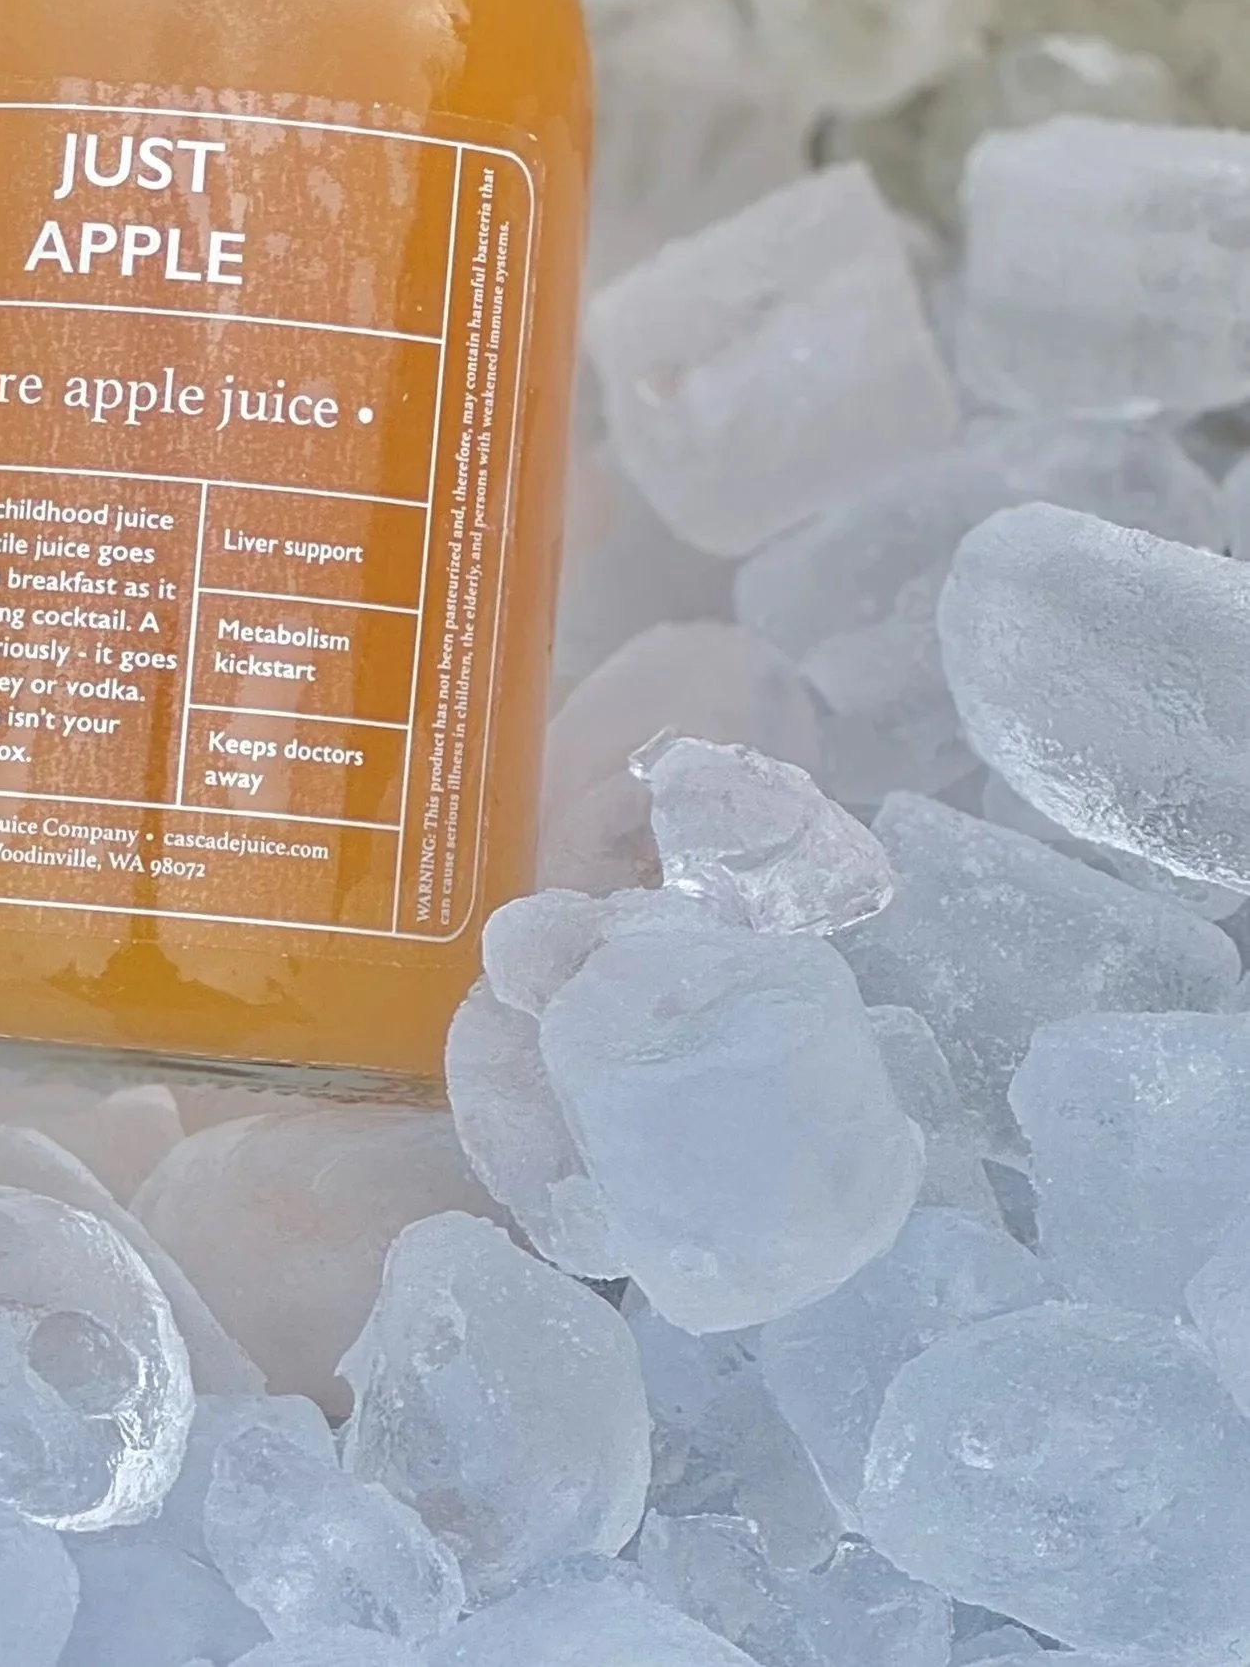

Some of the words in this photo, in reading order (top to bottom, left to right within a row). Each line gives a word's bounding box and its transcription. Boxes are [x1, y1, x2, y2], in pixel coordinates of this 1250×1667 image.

[53, 132, 226, 200] JUST
[478, 168, 495, 199] that
[472, 202, 492, 264] bacteria
[23, 220, 246, 285] APPLE
[495, 221, 510, 284] systems.
[466, 265, 486, 329] harmful
[489, 285, 504, 350] immune
[465, 332, 480, 390] contain
[63, 366, 205, 426] apple
[215, 374, 339, 432] juice
[462, 392, 478, 425] may
[481, 352, 498, 428] weakened
[452, 428, 473, 502] therefore,
[477, 431, 491, 466] with
[474, 469, 488, 528] persons
[114, 507, 175, 533] juice
[450, 505, 467, 539] and,
[34, 536, 91, 561] juice
[97, 545, 156, 567] goes
[223, 528, 279, 554] Liver
[284, 540, 364, 565] support
[469, 531, 483, 561] and
[7, 566, 117, 595] breakfast
[123, 581, 150, 598] as
[158, 578, 177, 600] it
[445, 541, 462, 630] pasteurized
[463, 563, 483, 620] elderly,
[31, 606, 132, 632] cocktail.
[138, 611, 160, 634] A
[217, 618, 350, 652] Metabolism
[459, 622, 475, 648] the
[95, 642, 113, 665] it
[118, 650, 177, 673] goes
[214, 651, 316, 682] kickstart
[436, 633, 454, 670] been
[30, 678, 58, 695] or
[66, 678, 146, 702] vodka.
[439, 673, 451, 700] not
[453, 651, 474, 719] children,
[7, 705, 56, 730] isn't
[62, 715, 121, 737] your
[431, 703, 448, 729] has
[451, 722, 466, 739] in
[208, 730, 277, 762] Keeps
[283, 738, 364, 767] doctors
[428, 732, 445, 793] product
[447, 741, 464, 790] illness
[204, 769, 264, 795] away
[423, 795, 440, 831] This
[444, 793, 460, 849] serious
[42, 817, 140, 848] Company
[163, 831, 329, 860] cascadejuice.com
[109, 852, 145, 873] WA
[150, 857, 206, 880] 98072
[416, 833, 436, 922] WARNING:
[442, 851, 455, 895] cause
[440, 897, 451, 926] can
